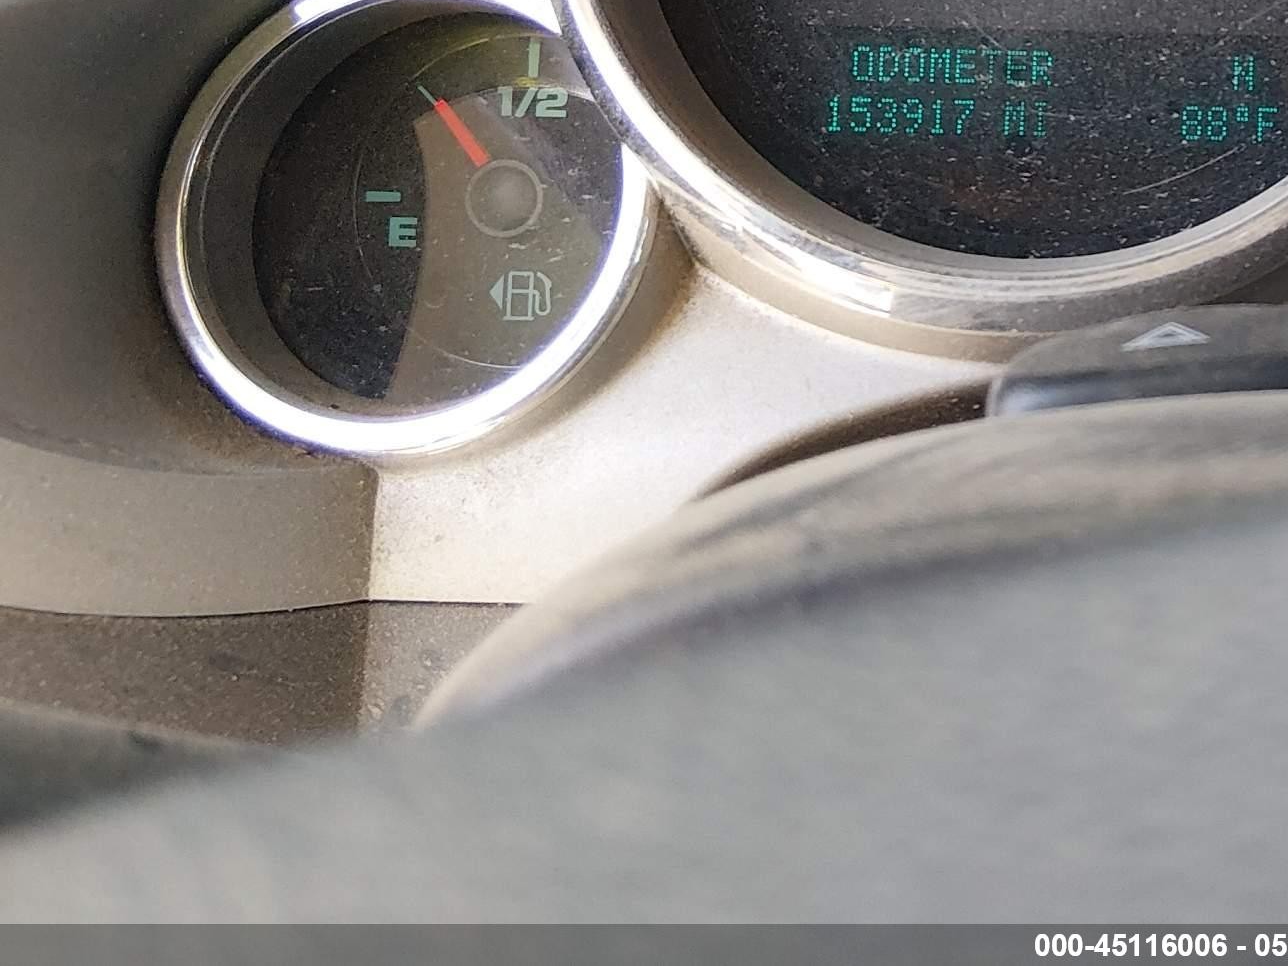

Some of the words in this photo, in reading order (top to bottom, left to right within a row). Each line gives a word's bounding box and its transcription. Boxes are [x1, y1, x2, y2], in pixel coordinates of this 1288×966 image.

[851, 46, 1053, 85] ODOMETER
[499, 87, 568, 118] 1/2
[827, 96, 976, 135] 153917
[1004, 100, 1048, 136] MI
[1181, 106, 1278, 142] 88°F
[388, 216, 418, 248] E
